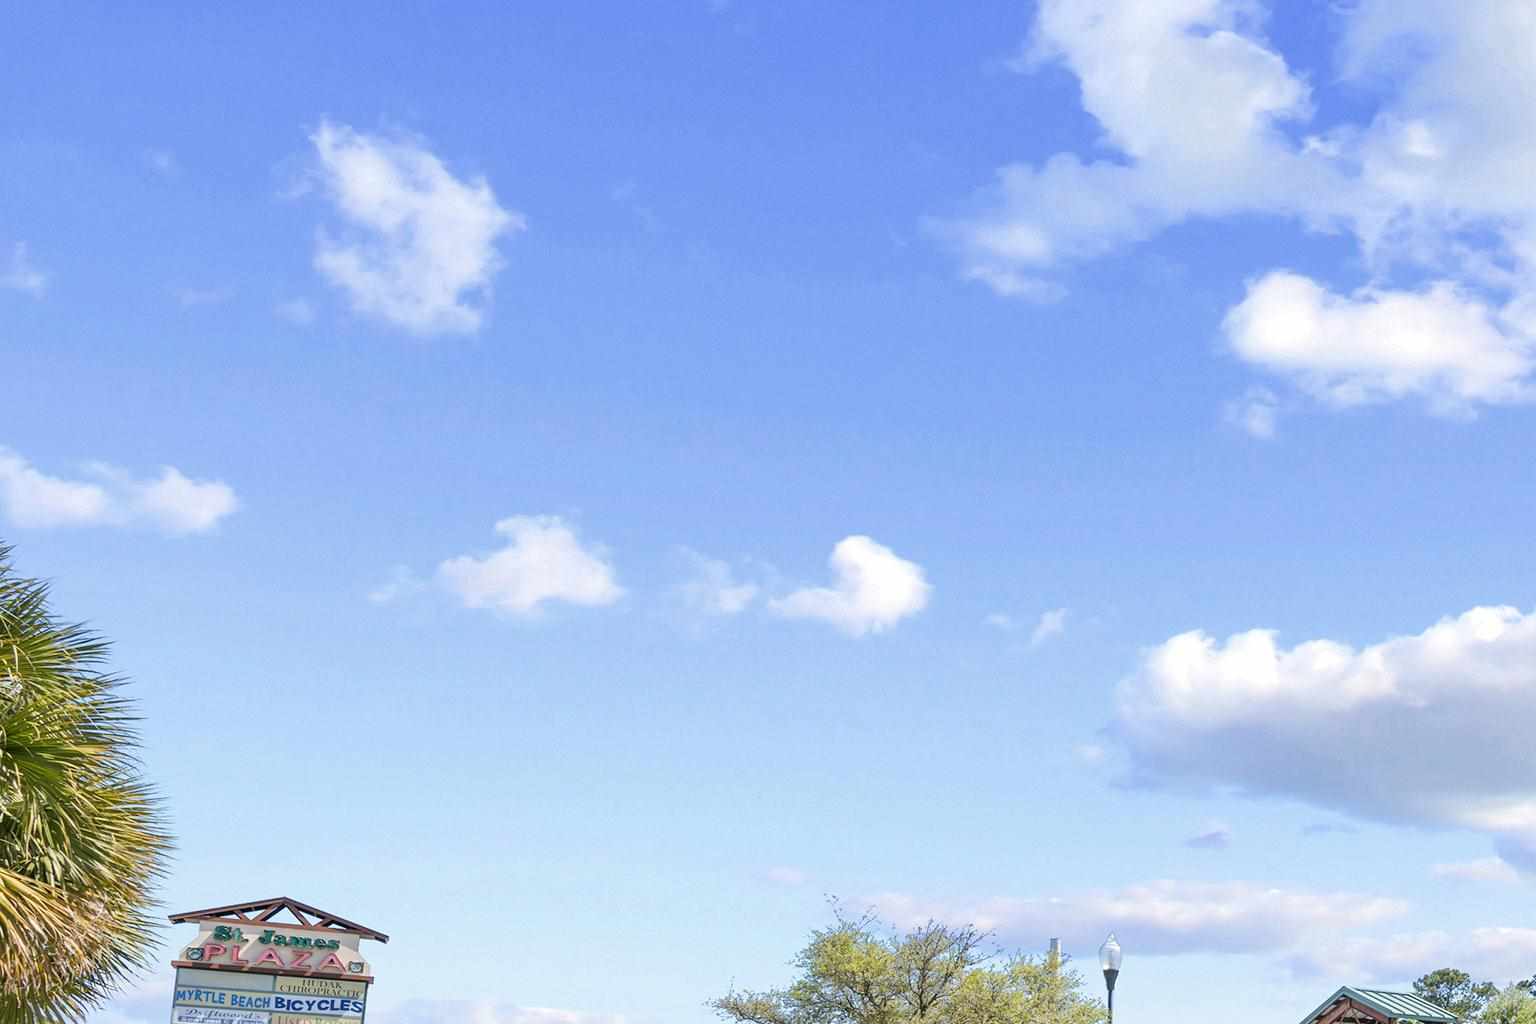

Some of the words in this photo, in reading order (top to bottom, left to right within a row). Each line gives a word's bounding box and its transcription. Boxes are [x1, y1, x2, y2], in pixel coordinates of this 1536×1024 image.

[258, 930, 340, 950] James
[203, 943, 347, 973] PLAZA
[176, 989, 226, 1004] MYRTLE
[231, 994, 271, 1008] BEACH
[279, 985, 364, 998] CHIROPRACTIC
[274, 997, 363, 1013] BICYCLES
